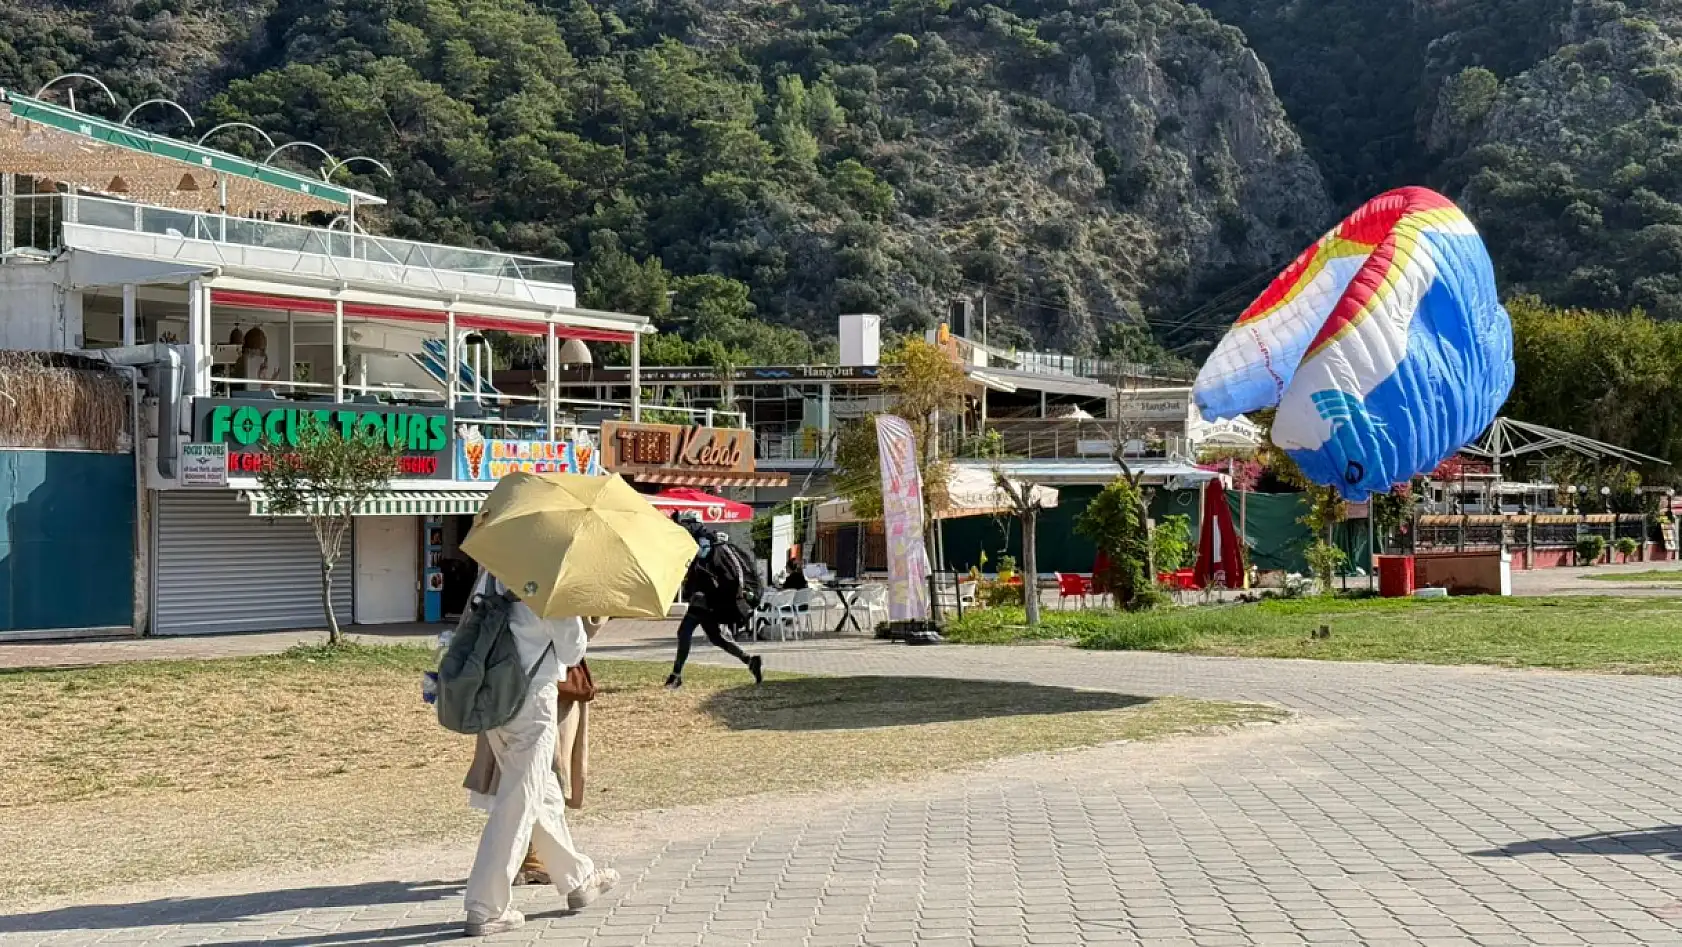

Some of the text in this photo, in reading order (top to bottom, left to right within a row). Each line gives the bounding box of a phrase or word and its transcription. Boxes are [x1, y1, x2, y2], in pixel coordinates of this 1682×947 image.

[212, 405, 448, 453] FOCUS TOURS
[492, 441, 568, 460] BUBBLE
[678, 423, 742, 466] Kebab
